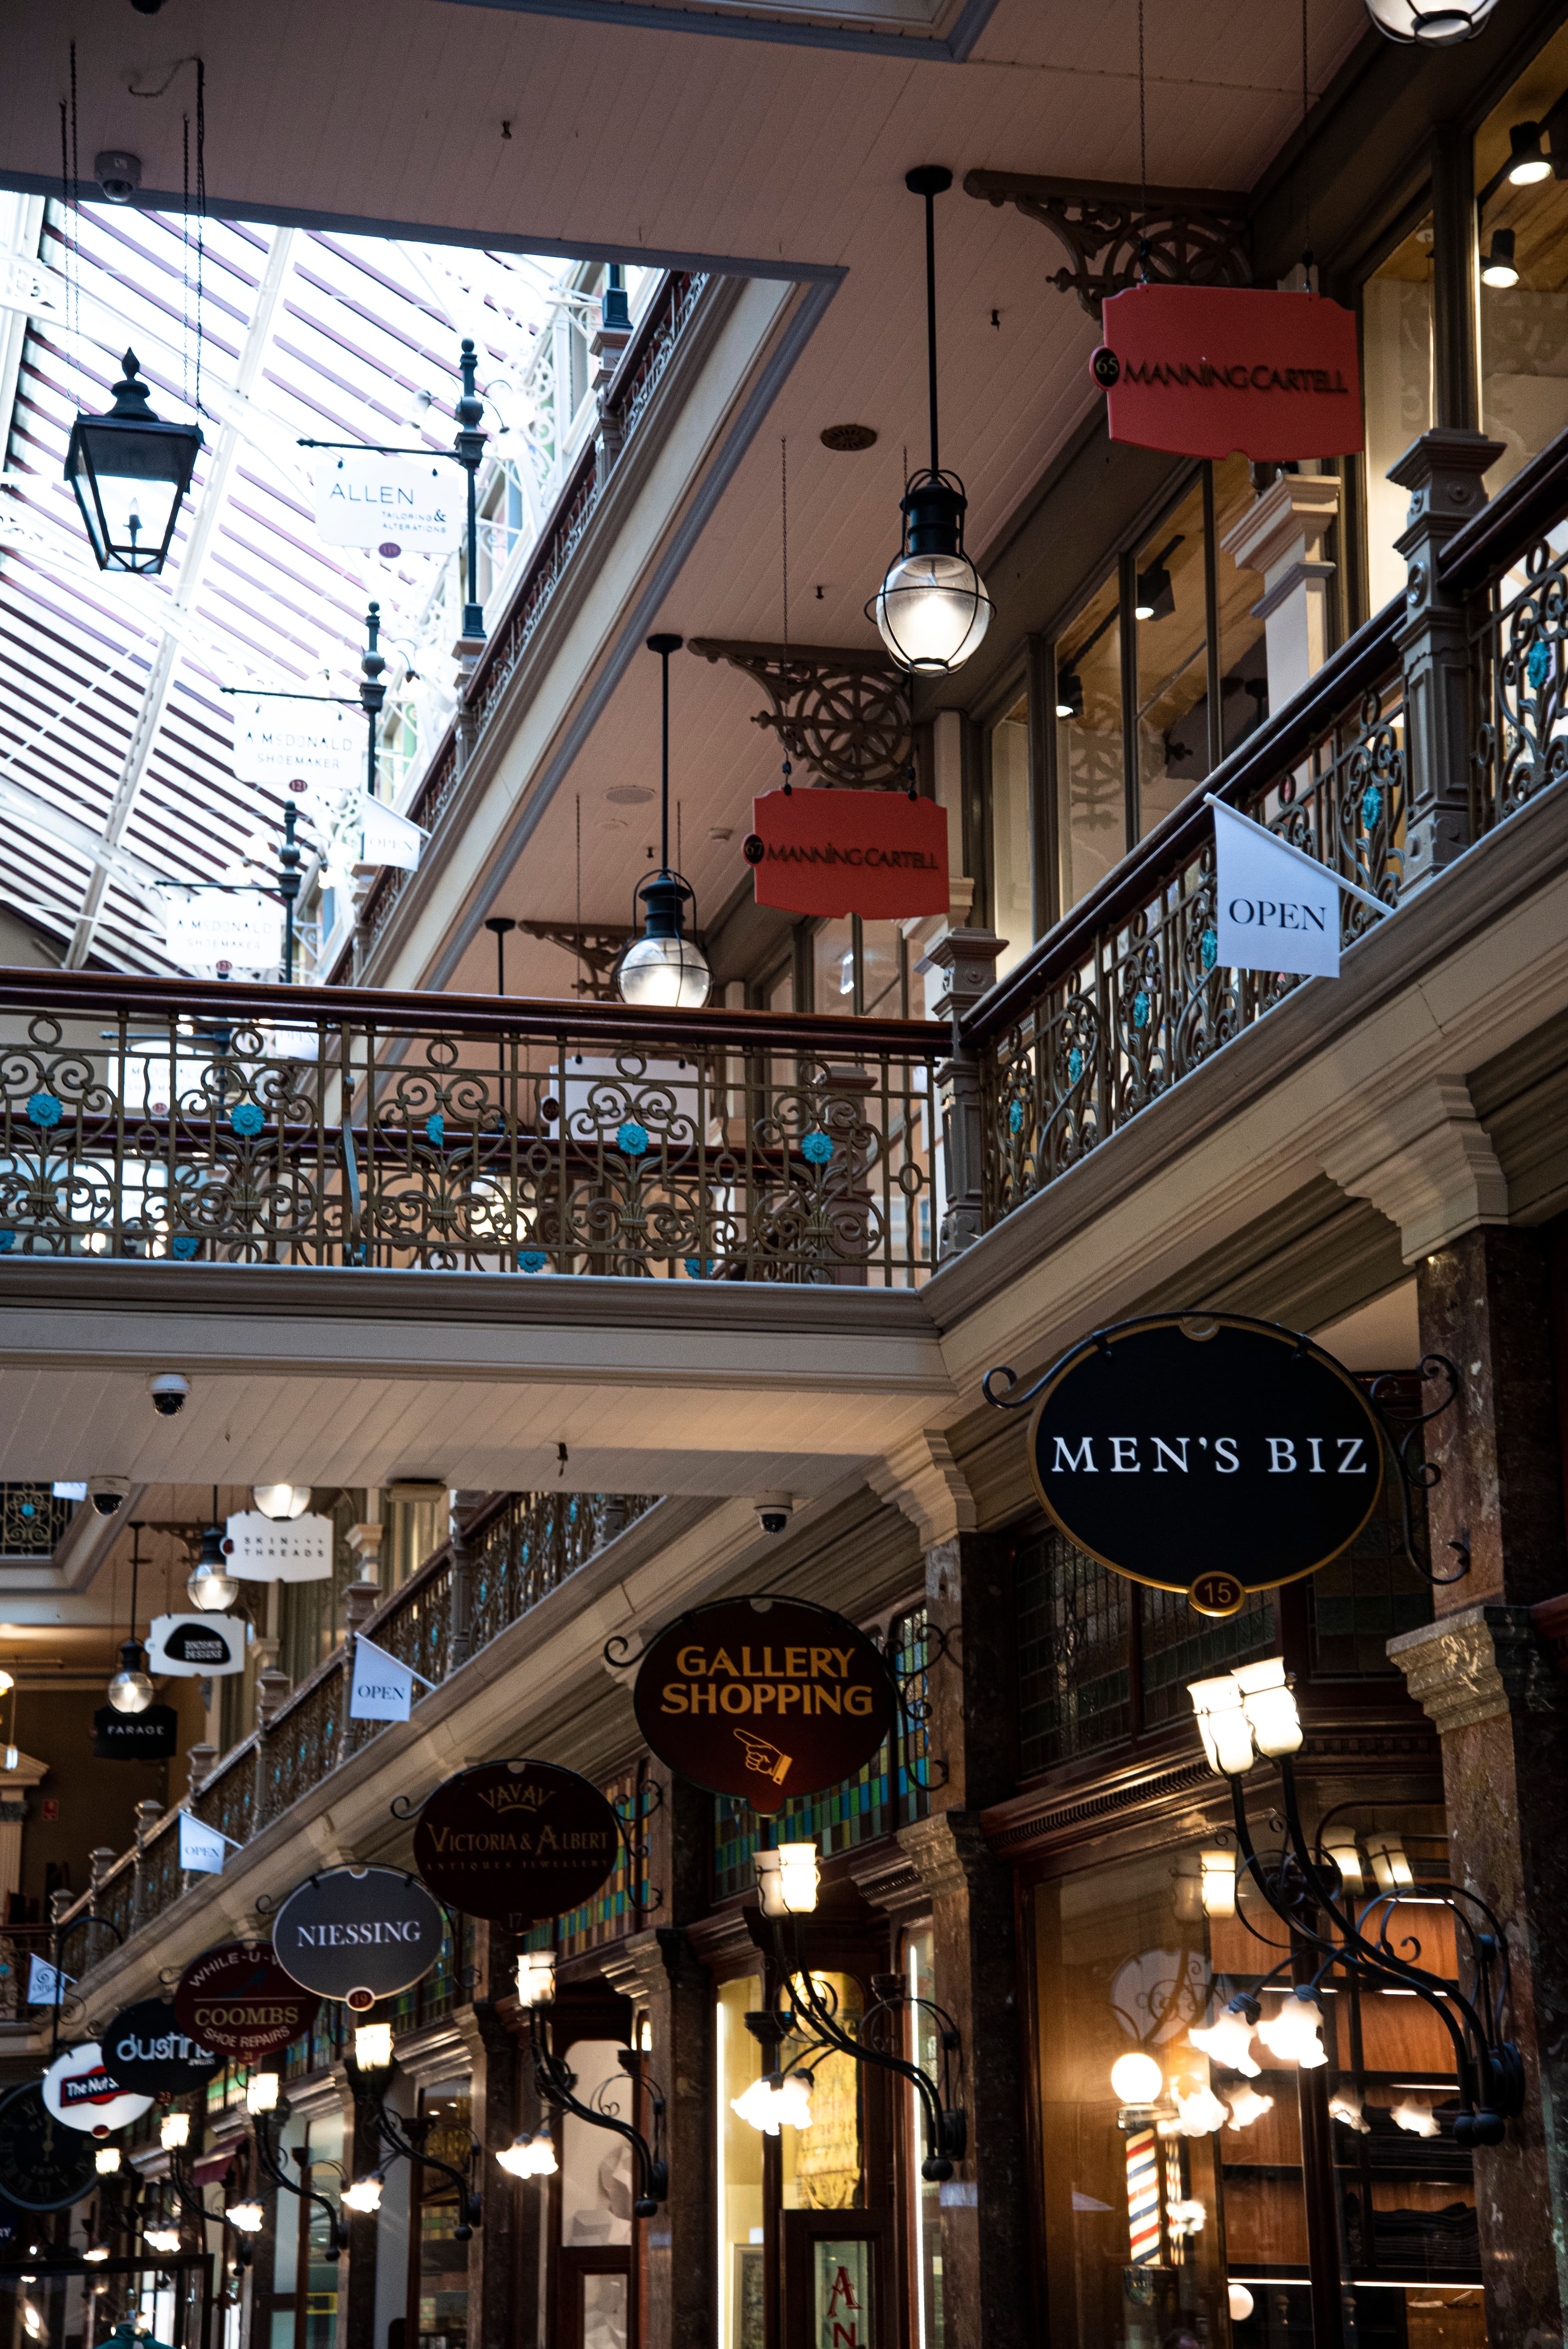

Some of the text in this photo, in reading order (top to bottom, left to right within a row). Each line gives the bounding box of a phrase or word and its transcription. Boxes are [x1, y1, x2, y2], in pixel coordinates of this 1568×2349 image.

[1095, 357, 1119, 375] 65
[330, 483, 413, 504] ALLEN
[383, 509, 446, 522] TAILORING &
[383, 523, 446, 533] ALTERATIONS
[258, 753, 339, 769] SHOEMAKER
[745, 841, 763, 855] 67
[1229, 898, 1326, 932] OPEN
[1051, 1436, 1367, 1473] MEN'S BIZ
[245, 1537, 288, 1545] SKIN
[245, 1548, 324, 1558] THREADS
[1204, 1582, 1232, 1604] 15
[676, 1645, 856, 1678] GALLERY
[358, 1685, 405, 1700] OPEN
[660, 1683, 874, 1716] SHOPPING
[520, 1834, 532, 1850] &
[185, 1846, 221, 1858] OPEN
[425, 1859, 609, 1872] ANTIQUES JEWELLERY
[509, 1912, 523, 1928] 17
[296, 1921, 422, 1948] NIESSING
[354, 1994, 368, 2005] 19
[194, 2006, 299, 2026] COOMBS
[203, 2025, 290, 2048] SHOE REPAIRS
[66, 2081, 87, 2098] The
